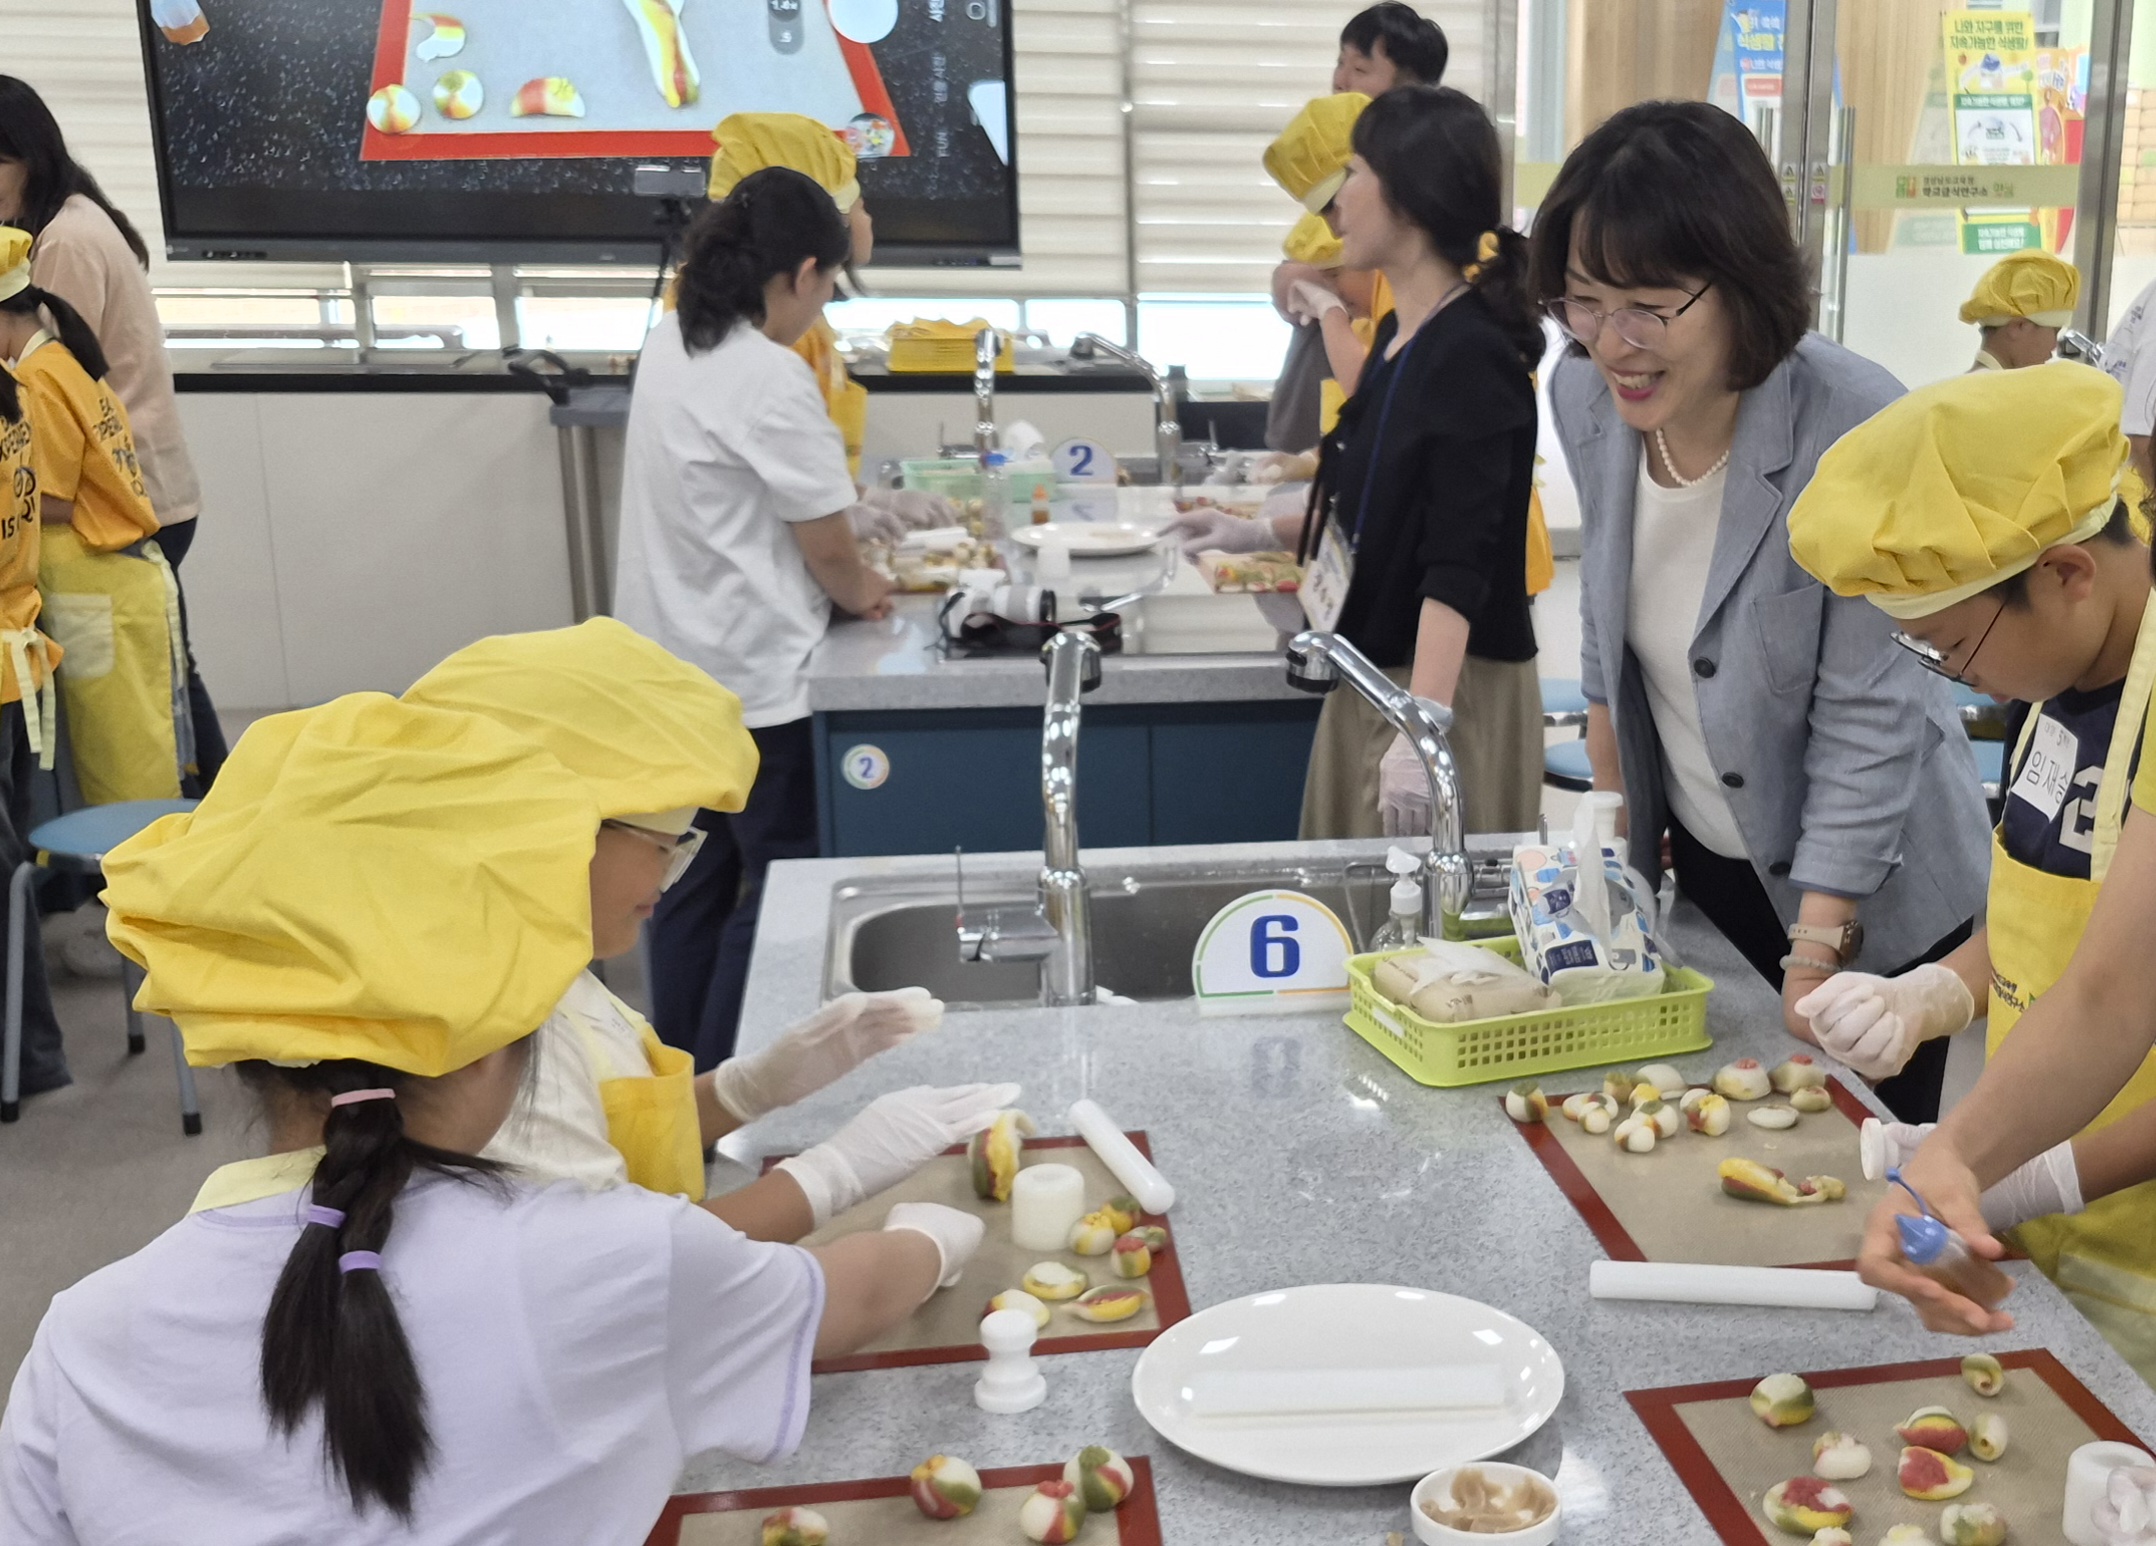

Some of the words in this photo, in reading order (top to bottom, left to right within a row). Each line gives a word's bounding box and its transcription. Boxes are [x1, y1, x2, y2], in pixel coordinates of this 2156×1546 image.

[1069, 444, 1095, 477] 2
[858, 756, 875, 779] 2
[2059, 765, 2104, 855] 2
[1249, 914, 1300, 978] 6
